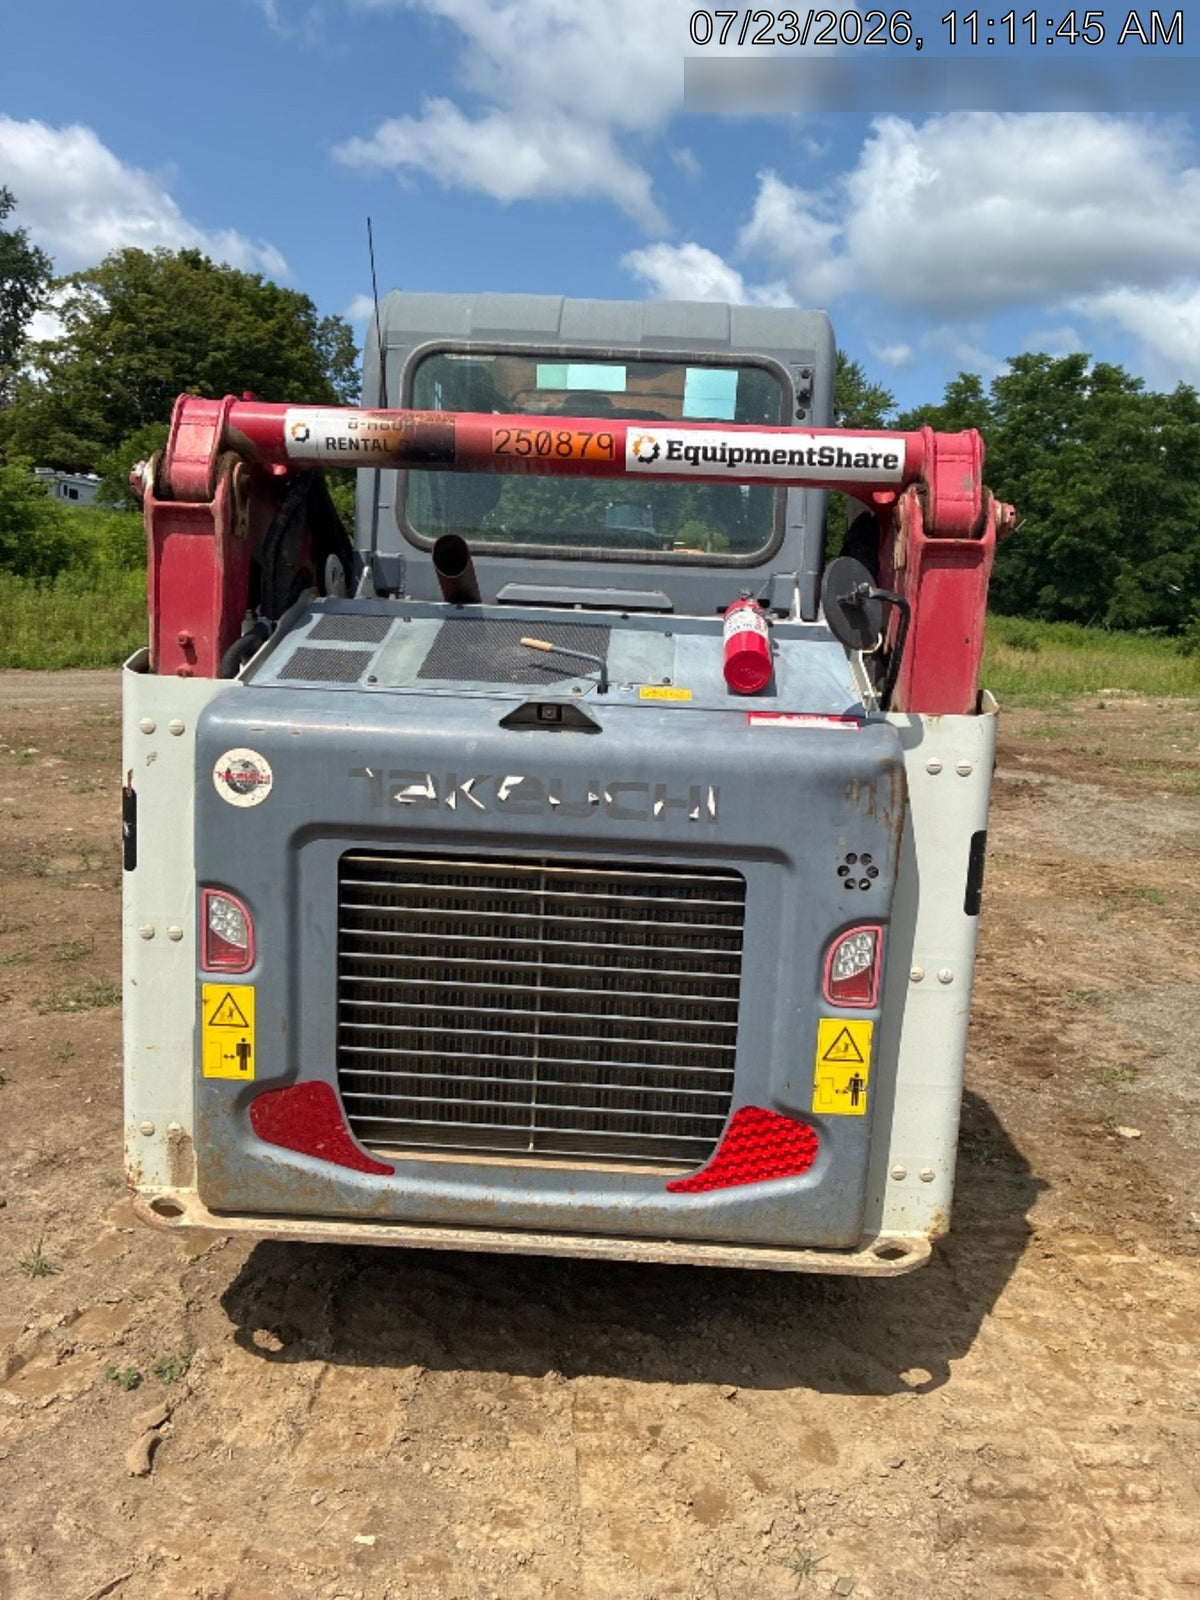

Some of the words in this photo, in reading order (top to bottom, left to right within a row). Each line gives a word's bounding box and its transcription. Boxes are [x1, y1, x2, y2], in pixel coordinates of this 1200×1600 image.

[325, 436, 392, 453] RENTAL
[493, 429, 615, 460] 250879
[665, 440, 899, 470] EquipmentShare
